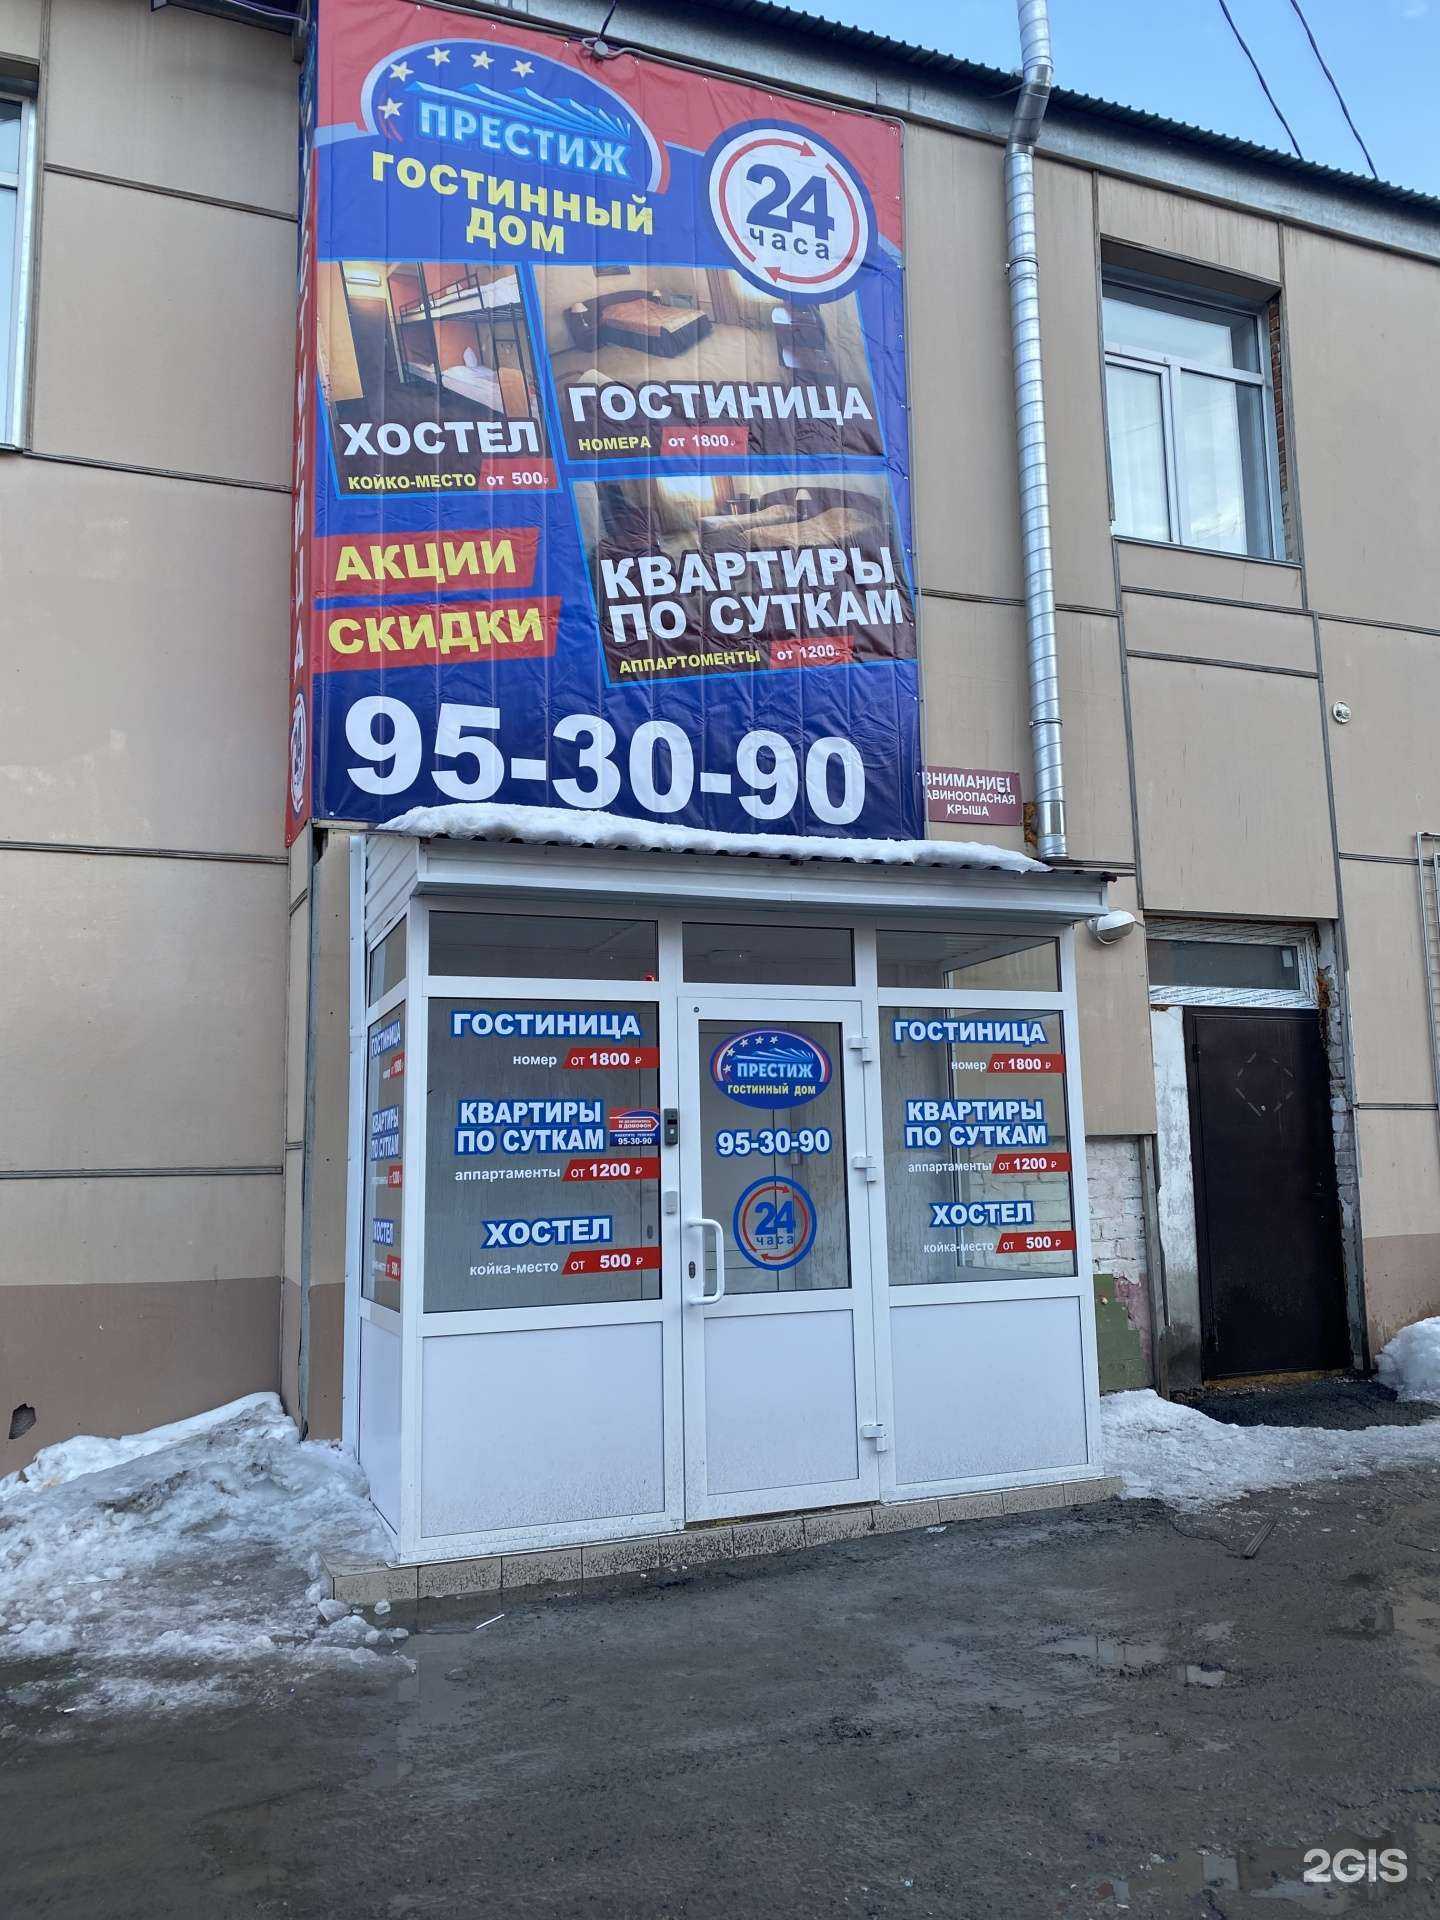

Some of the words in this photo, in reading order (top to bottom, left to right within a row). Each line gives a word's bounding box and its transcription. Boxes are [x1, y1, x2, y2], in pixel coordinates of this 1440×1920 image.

[420, 102, 628, 176] ПРЕСТИЖ
[372, 151, 654, 235] ГОСТИННЫЙ
[745, 164, 835, 242] 24
[466, 207, 565, 254] ДОМ
[749, 227, 831, 261] часа
[569, 384, 872, 425] ГОСТИНИЦА
[340, 421, 539, 457] ХОСТЕЛ
[578, 435, 651, 451] НОМЕРА
[668, 438, 686, 447] от
[348, 473, 476, 490] КОЙКО-МЕСТО
[487, 476, 504, 486] от
[334, 539, 516, 583] АКЦИИ
[600, 545, 896, 598] КВАРТИРЫ
[609, 602, 686, 643] ПО
[709, 590, 904, 635] СУТКАМ
[328, 607, 544, 655] СКИДКИ
[619, 651, 761, 674] АППАРТОМЕНТЫ
[777, 651, 793, 661] от
[344, 696, 866, 825] 95-30-90
[925, 789, 1016, 805] АВИНООПАСНАЯ
[946, 804, 989, 816] КРЫША
[454, 1013, 640, 1039] ГОСТИНИЦА
[894, 1021, 1046, 1046] ГОСТИНИЦА
[513, 1056, 557, 1068] номер
[571, 1057, 585, 1066] от
[590, 1052, 630, 1066] 1800
[737, 1062, 813, 1079] ПРЕСТИЖ
[951, 1061, 987, 1073] номер
[994, 1061, 1005, 1070] от
[1008, 1058, 1041, 1070] 1800
[461, 1102, 600, 1124] КВАРТИРЫ
[908, 1101, 1042, 1121] КВАРТИРЫ
[458, 1130, 495, 1152] ПО
[503, 1129, 603, 1152] СУТКАМ
[618, 1137, 652, 1145] 95-30-90
[718, 1130, 830, 1155] 95-30-90
[907, 1127, 941, 1146] ПО
[950, 1126, 1047, 1145] СУТКАМ
[455, 1167, 560, 1182] аппартаменты
[571, 1168, 585, 1178] от
[589, 1163, 630, 1177] 1200
[908, 1161, 992, 1174] аппартаменты
[999, 1162, 1010, 1171] от
[1014, 1158, 1047, 1170] 1200
[754, 1201, 794, 1236] 24
[932, 1203, 1032, 1225] ХОСТЕЛ
[486, 1218, 610, 1246] ХОСТЕЛ
[756, 1235, 794, 1246] часа
[924, 1240, 994, 1253] койка-место
[1003, 1241, 1014, 1250] от
[1026, 1236, 1051, 1249] 500
[470, 1261, 558, 1276] койка-место
[571, 1261, 585, 1271] от
[600, 1254, 631, 1268] 500
